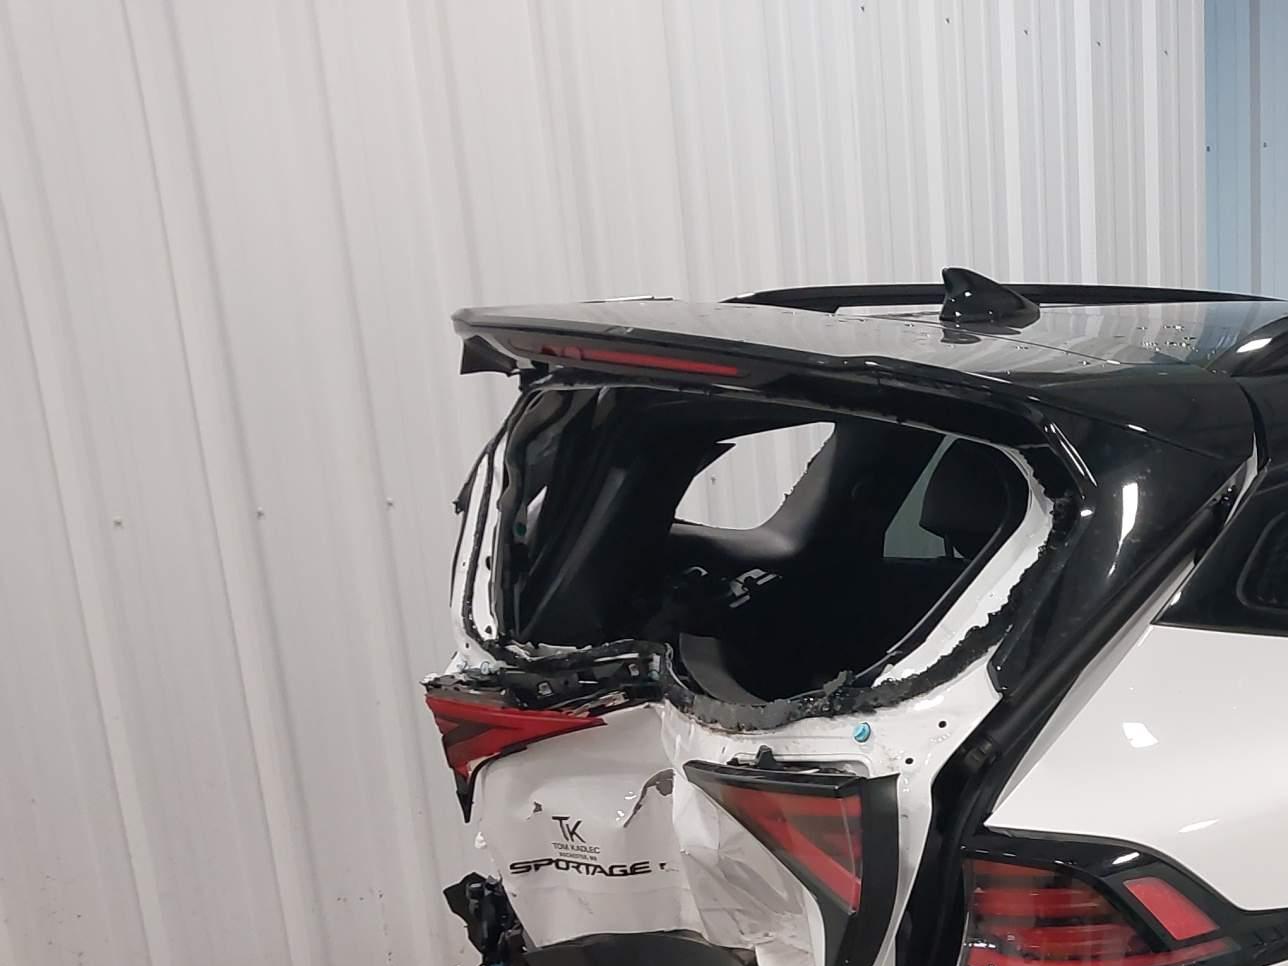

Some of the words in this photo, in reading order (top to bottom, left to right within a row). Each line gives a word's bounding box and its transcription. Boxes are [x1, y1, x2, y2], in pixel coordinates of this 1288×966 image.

[552, 816, 586, 843] TK
[570, 846, 600, 854] KADLEC
[509, 858, 652, 877] SPORTAGE
